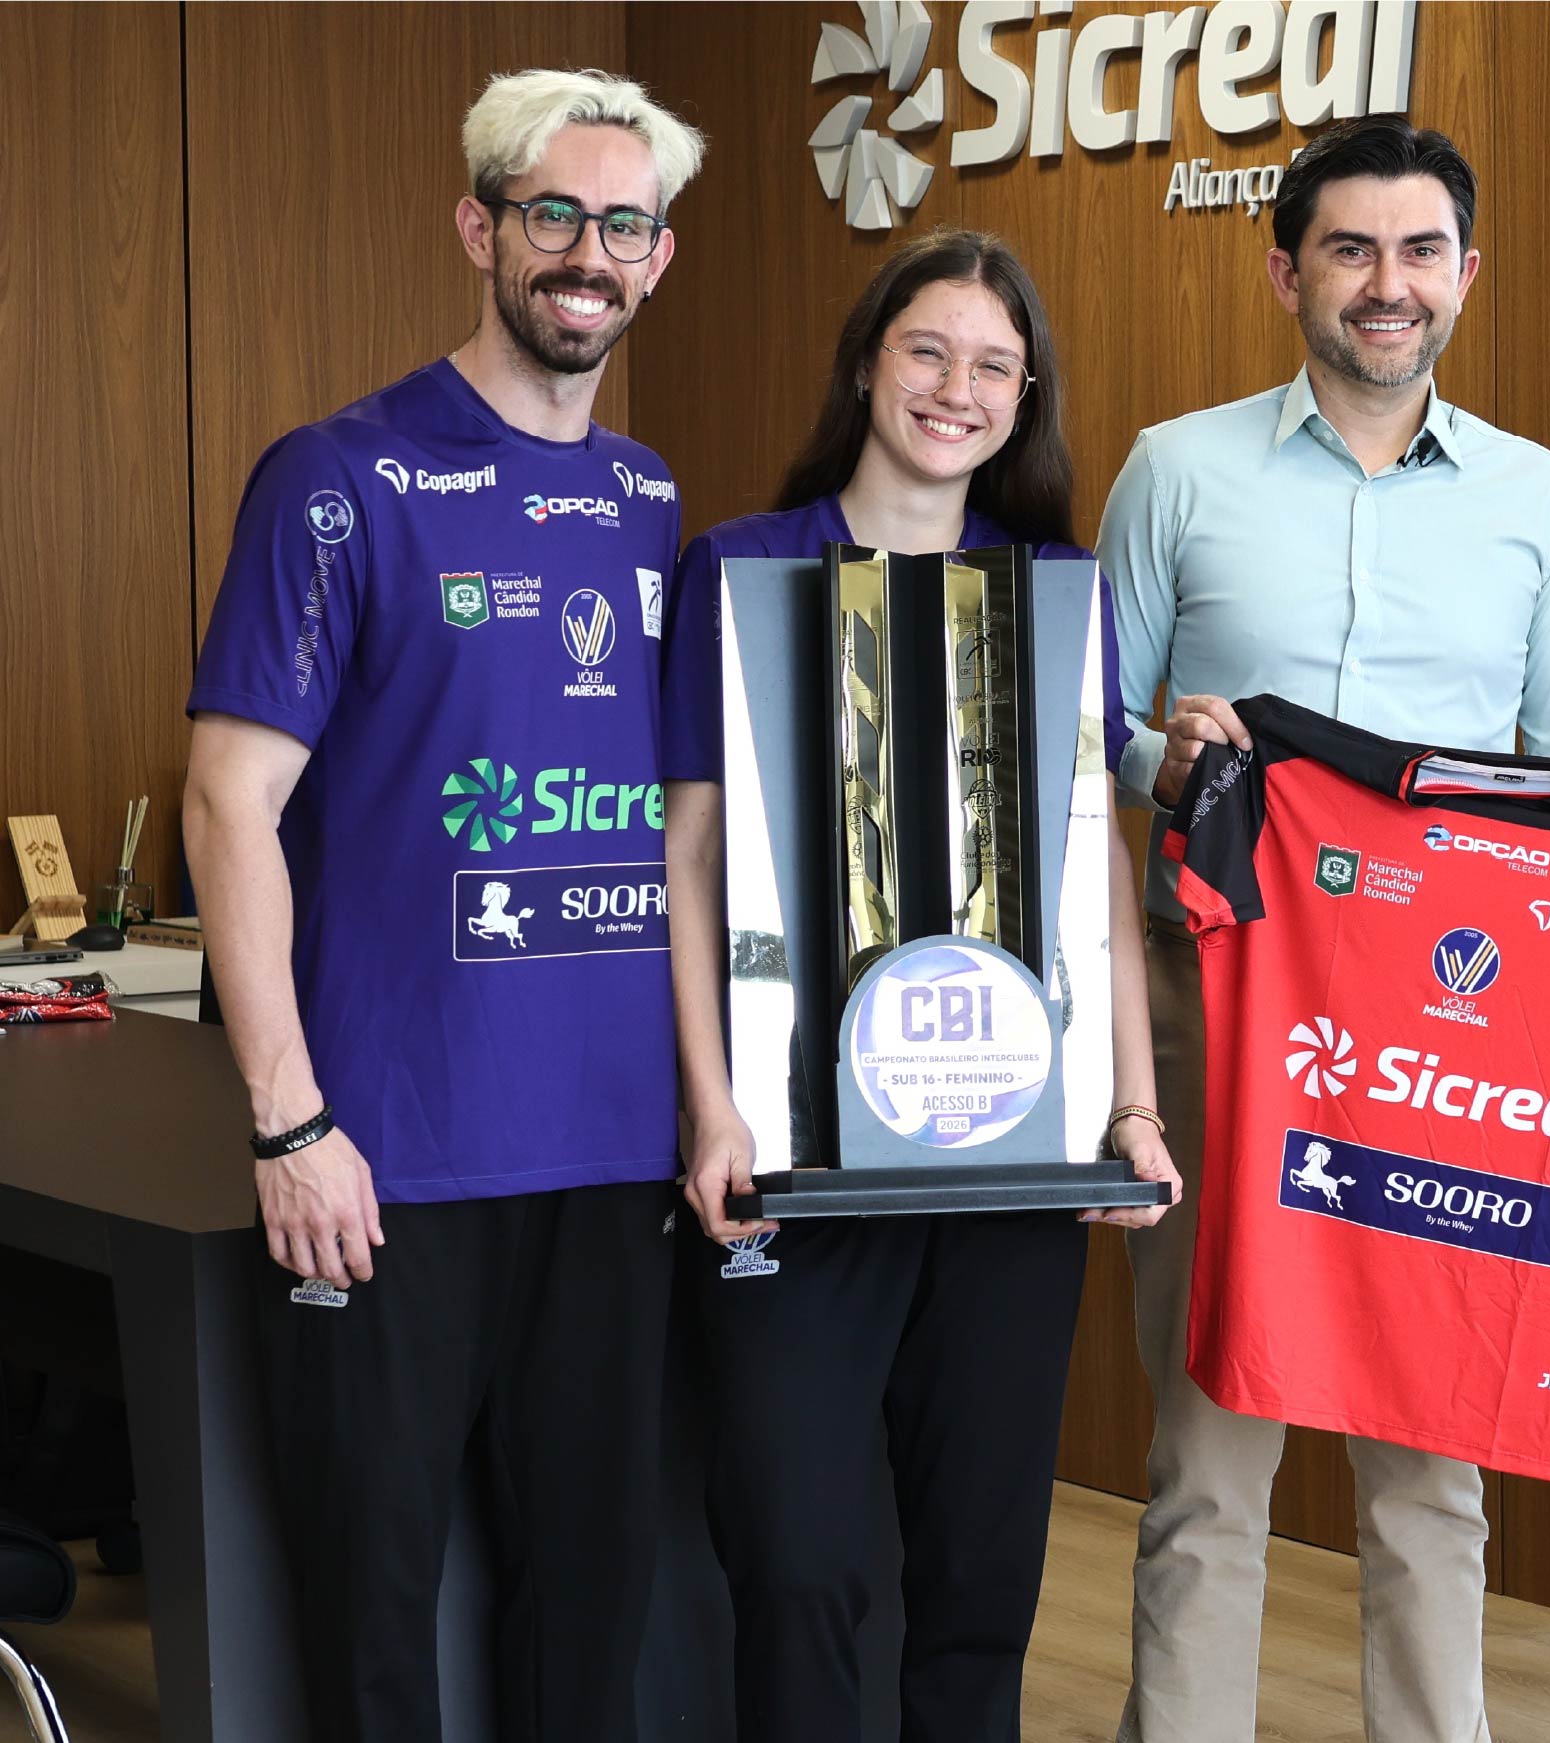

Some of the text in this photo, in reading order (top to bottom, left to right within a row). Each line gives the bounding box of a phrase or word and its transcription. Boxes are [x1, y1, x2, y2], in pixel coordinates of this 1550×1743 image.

[1164, 159, 1284, 217] Aliança
[416, 464, 497, 495] Copagril
[547, 497, 619, 518] OPÇÃO
[595, 516, 621, 528] TELECOM
[303, 546, 336, 619] MOVE
[492, 575, 542, 590] Marechal
[494, 590, 541, 605] Cândido
[496, 604, 540, 618] Rondon
[577, 668, 603, 684] VÔLEI
[564, 684, 618, 697] MARECHAL
[531, 767, 666, 834] Sicre
[1453, 834, 1550, 867] OPÇÃO
[1367, 860, 1423, 883] Marechal
[1507, 861, 1549, 877] TELECOM
[1365, 873, 1416, 894] Cândido
[562, 884, 670, 920] SOOR
[1363, 885, 1411, 905] Rondon
[595, 922, 644, 934] By the Whey
[1442, 996, 1476, 1012] VÔLEI
[901, 985, 994, 1042] CBI
[1422, 1004, 1489, 1028] MARECHAL
[864, 1053, 1040, 1065] CAMPEONATO BRASILEIRO INTERCLUBES
[891, 1074, 918, 1085] SUB
[922, 1074, 935, 1085] 16
[945, 1072, 1014, 1085] FEMININO
[922, 1095, 988, 1112] ACESSO B
[939, 1120, 967, 1131] 2026
[1383, 1171, 1533, 1230] SOORO
[1425, 1214, 1475, 1234] By the Whey
[734, 1253, 762, 1265] VÔLEI
[723, 1262, 776, 1276] MARECHAL
[305, 1280, 332, 1293] VÔLEI
[293, 1290, 345, 1305] MARECHAL
